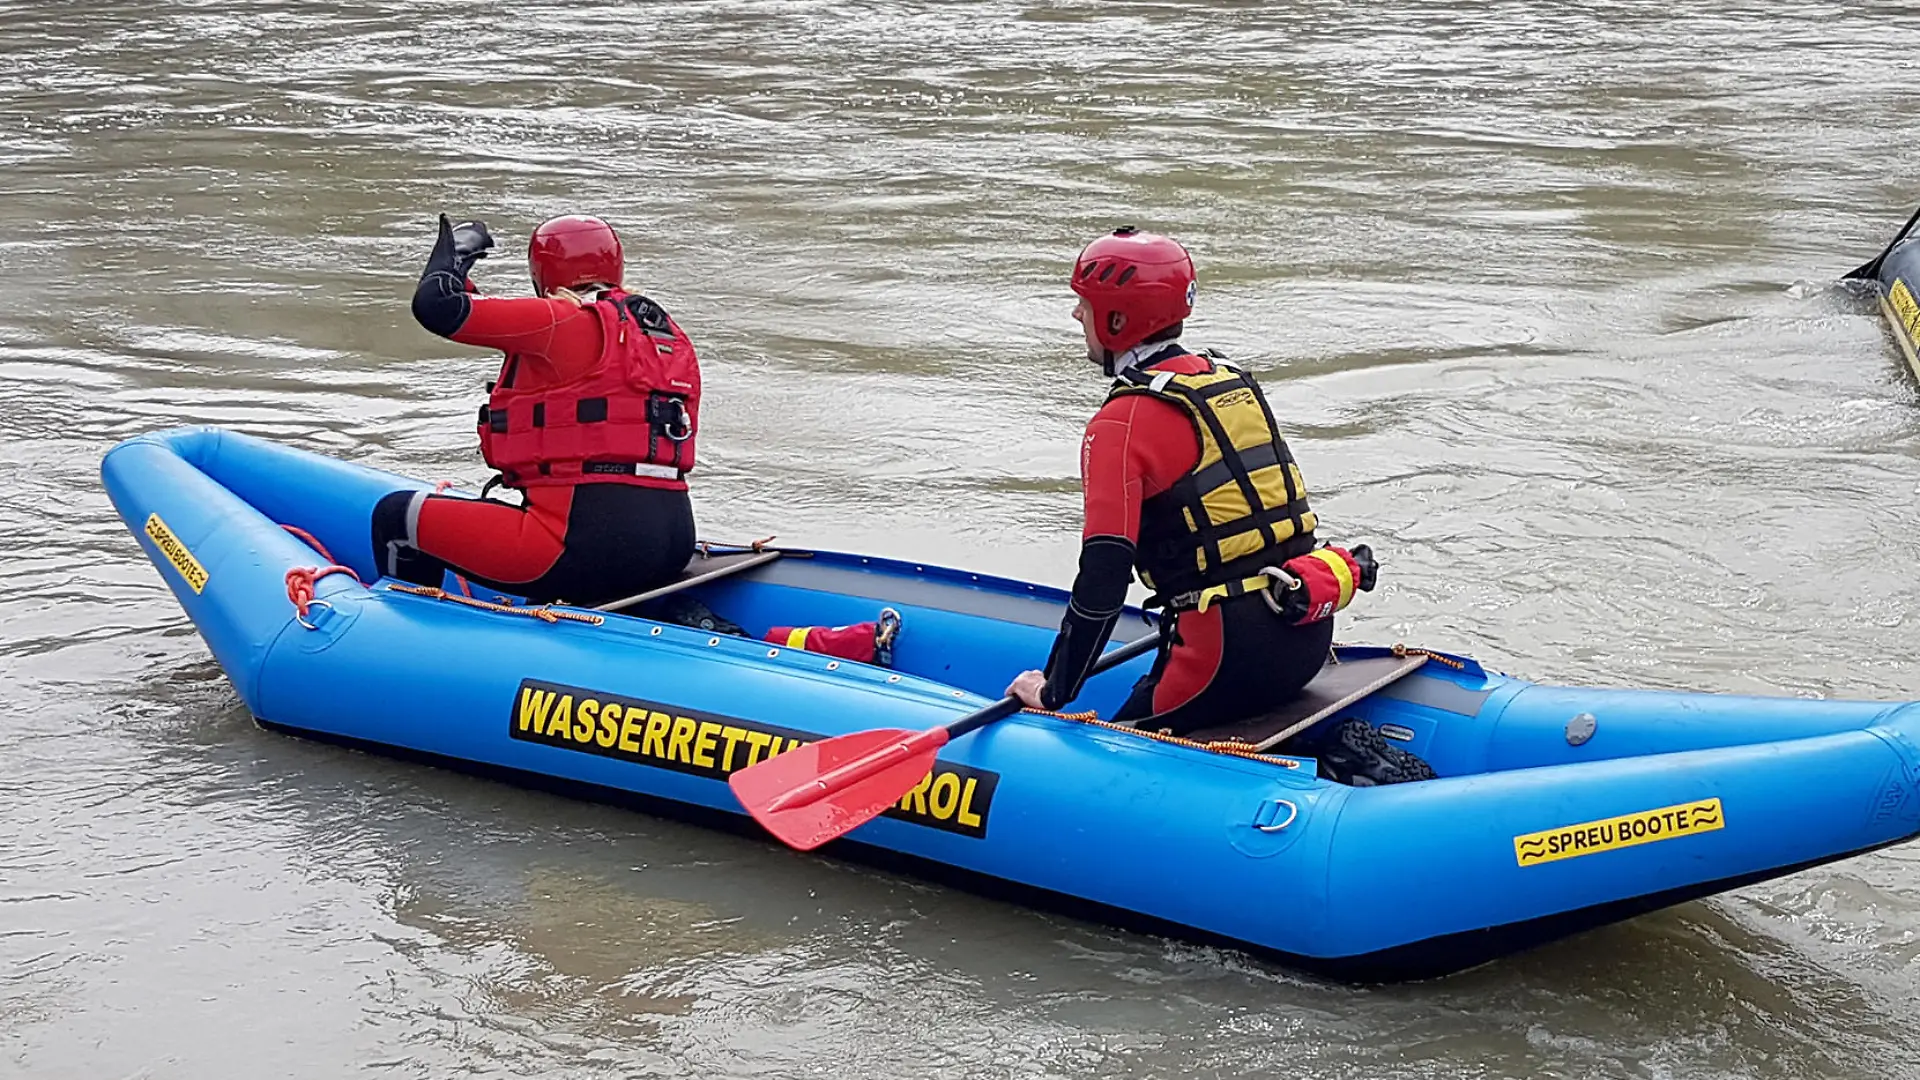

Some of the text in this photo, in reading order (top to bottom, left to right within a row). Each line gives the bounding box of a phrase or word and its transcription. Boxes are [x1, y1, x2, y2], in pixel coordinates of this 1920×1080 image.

[519, 687, 981, 828] WASSERRETT ROL
[1548, 810, 1689, 854] SPREU BOOTE
